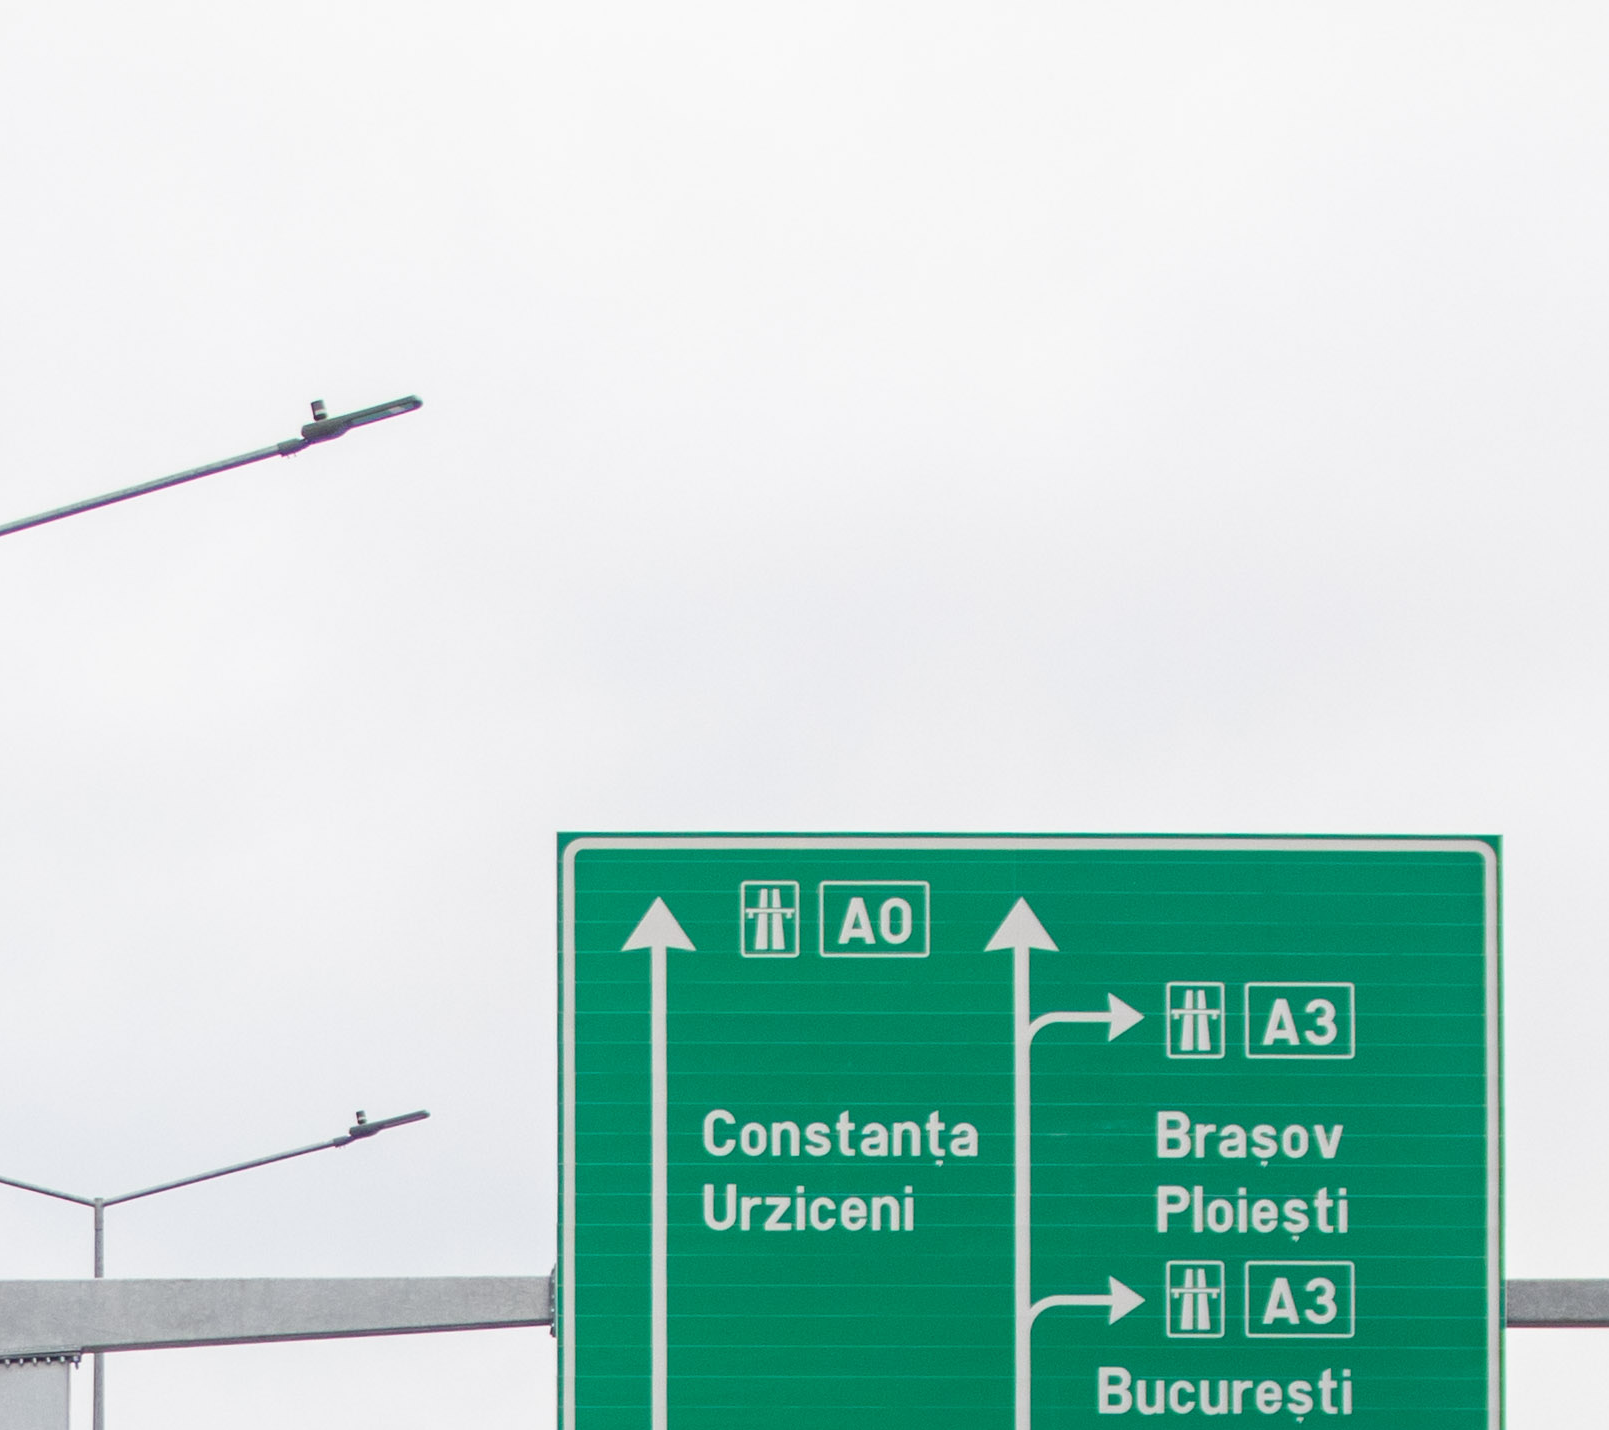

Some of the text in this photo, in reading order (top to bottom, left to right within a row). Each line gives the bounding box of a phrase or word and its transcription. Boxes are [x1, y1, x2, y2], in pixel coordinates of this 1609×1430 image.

[838, 897, 912, 945] A0
[1263, 999, 1337, 1045] A3
[703, 1109, 979, 1167] Constanța
[1156, 1110, 1343, 1167] Brașov
[703, 1184, 914, 1231] Urziceni
[1156, 1185, 1349, 1242] Ploiești
[1263, 1278, 1337, 1324] A3
[1098, 1367, 1352, 1423] București
